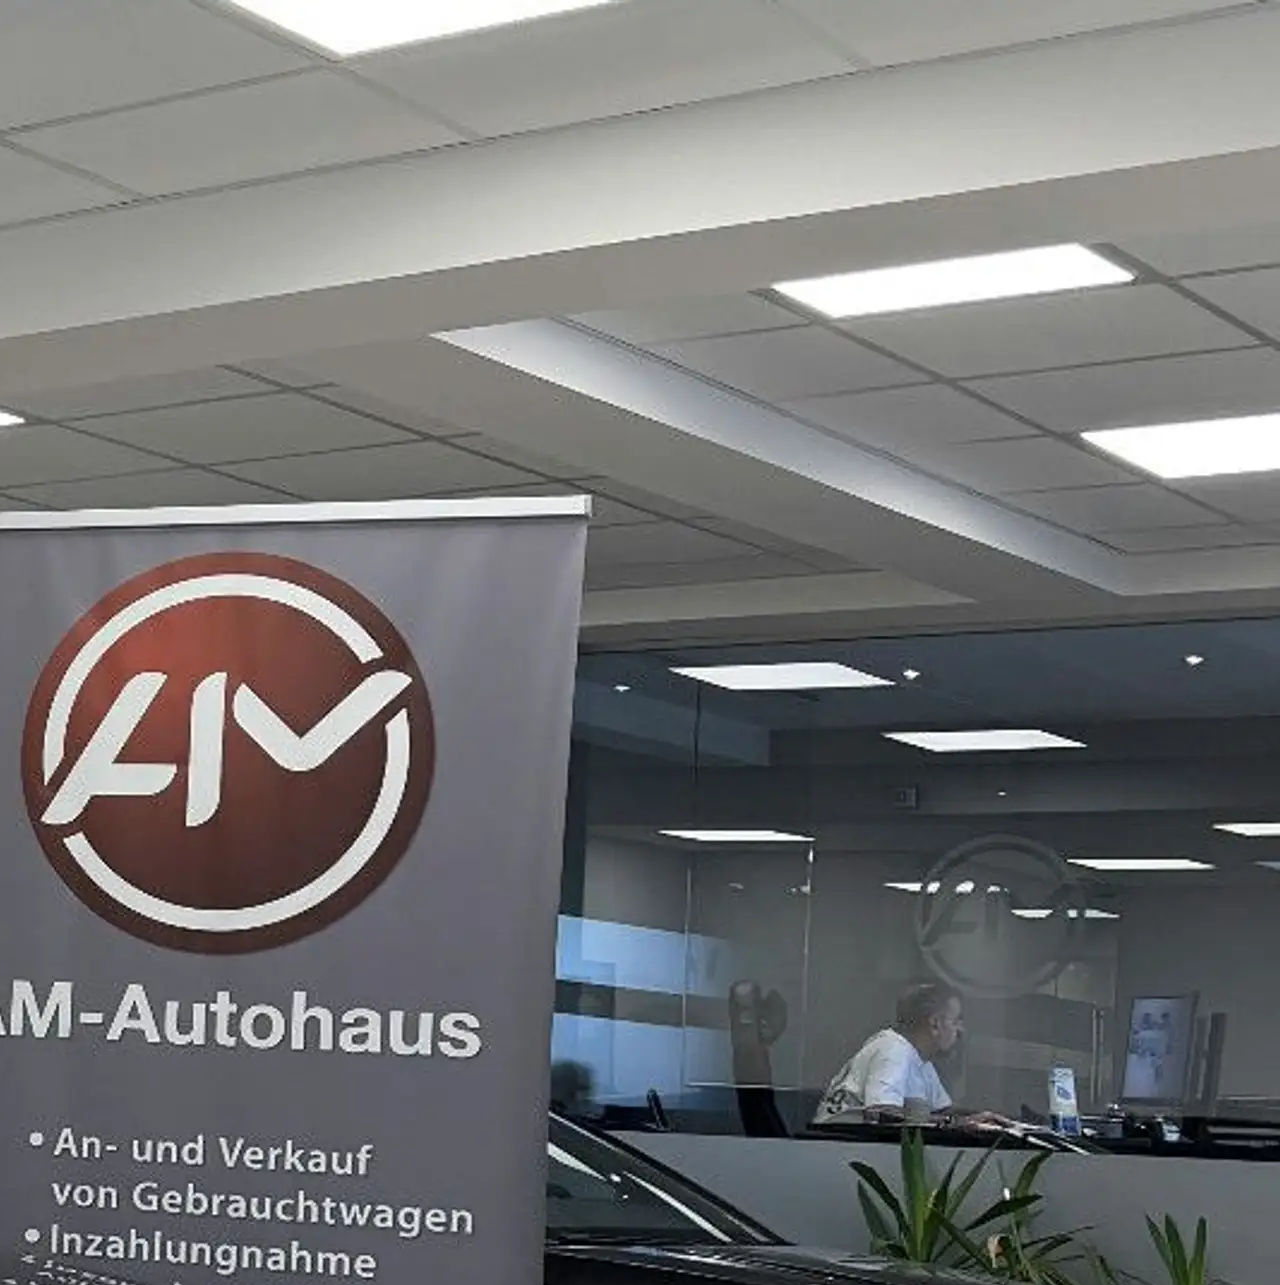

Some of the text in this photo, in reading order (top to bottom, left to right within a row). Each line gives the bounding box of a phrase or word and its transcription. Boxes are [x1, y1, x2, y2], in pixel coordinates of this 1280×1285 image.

[52, 1127, 374, 1176] An- und Verkauf
[51, 1181, 475, 1238] von Gebrauchtwagen
[49, 1223, 378, 1279] Inzahlungnahme
